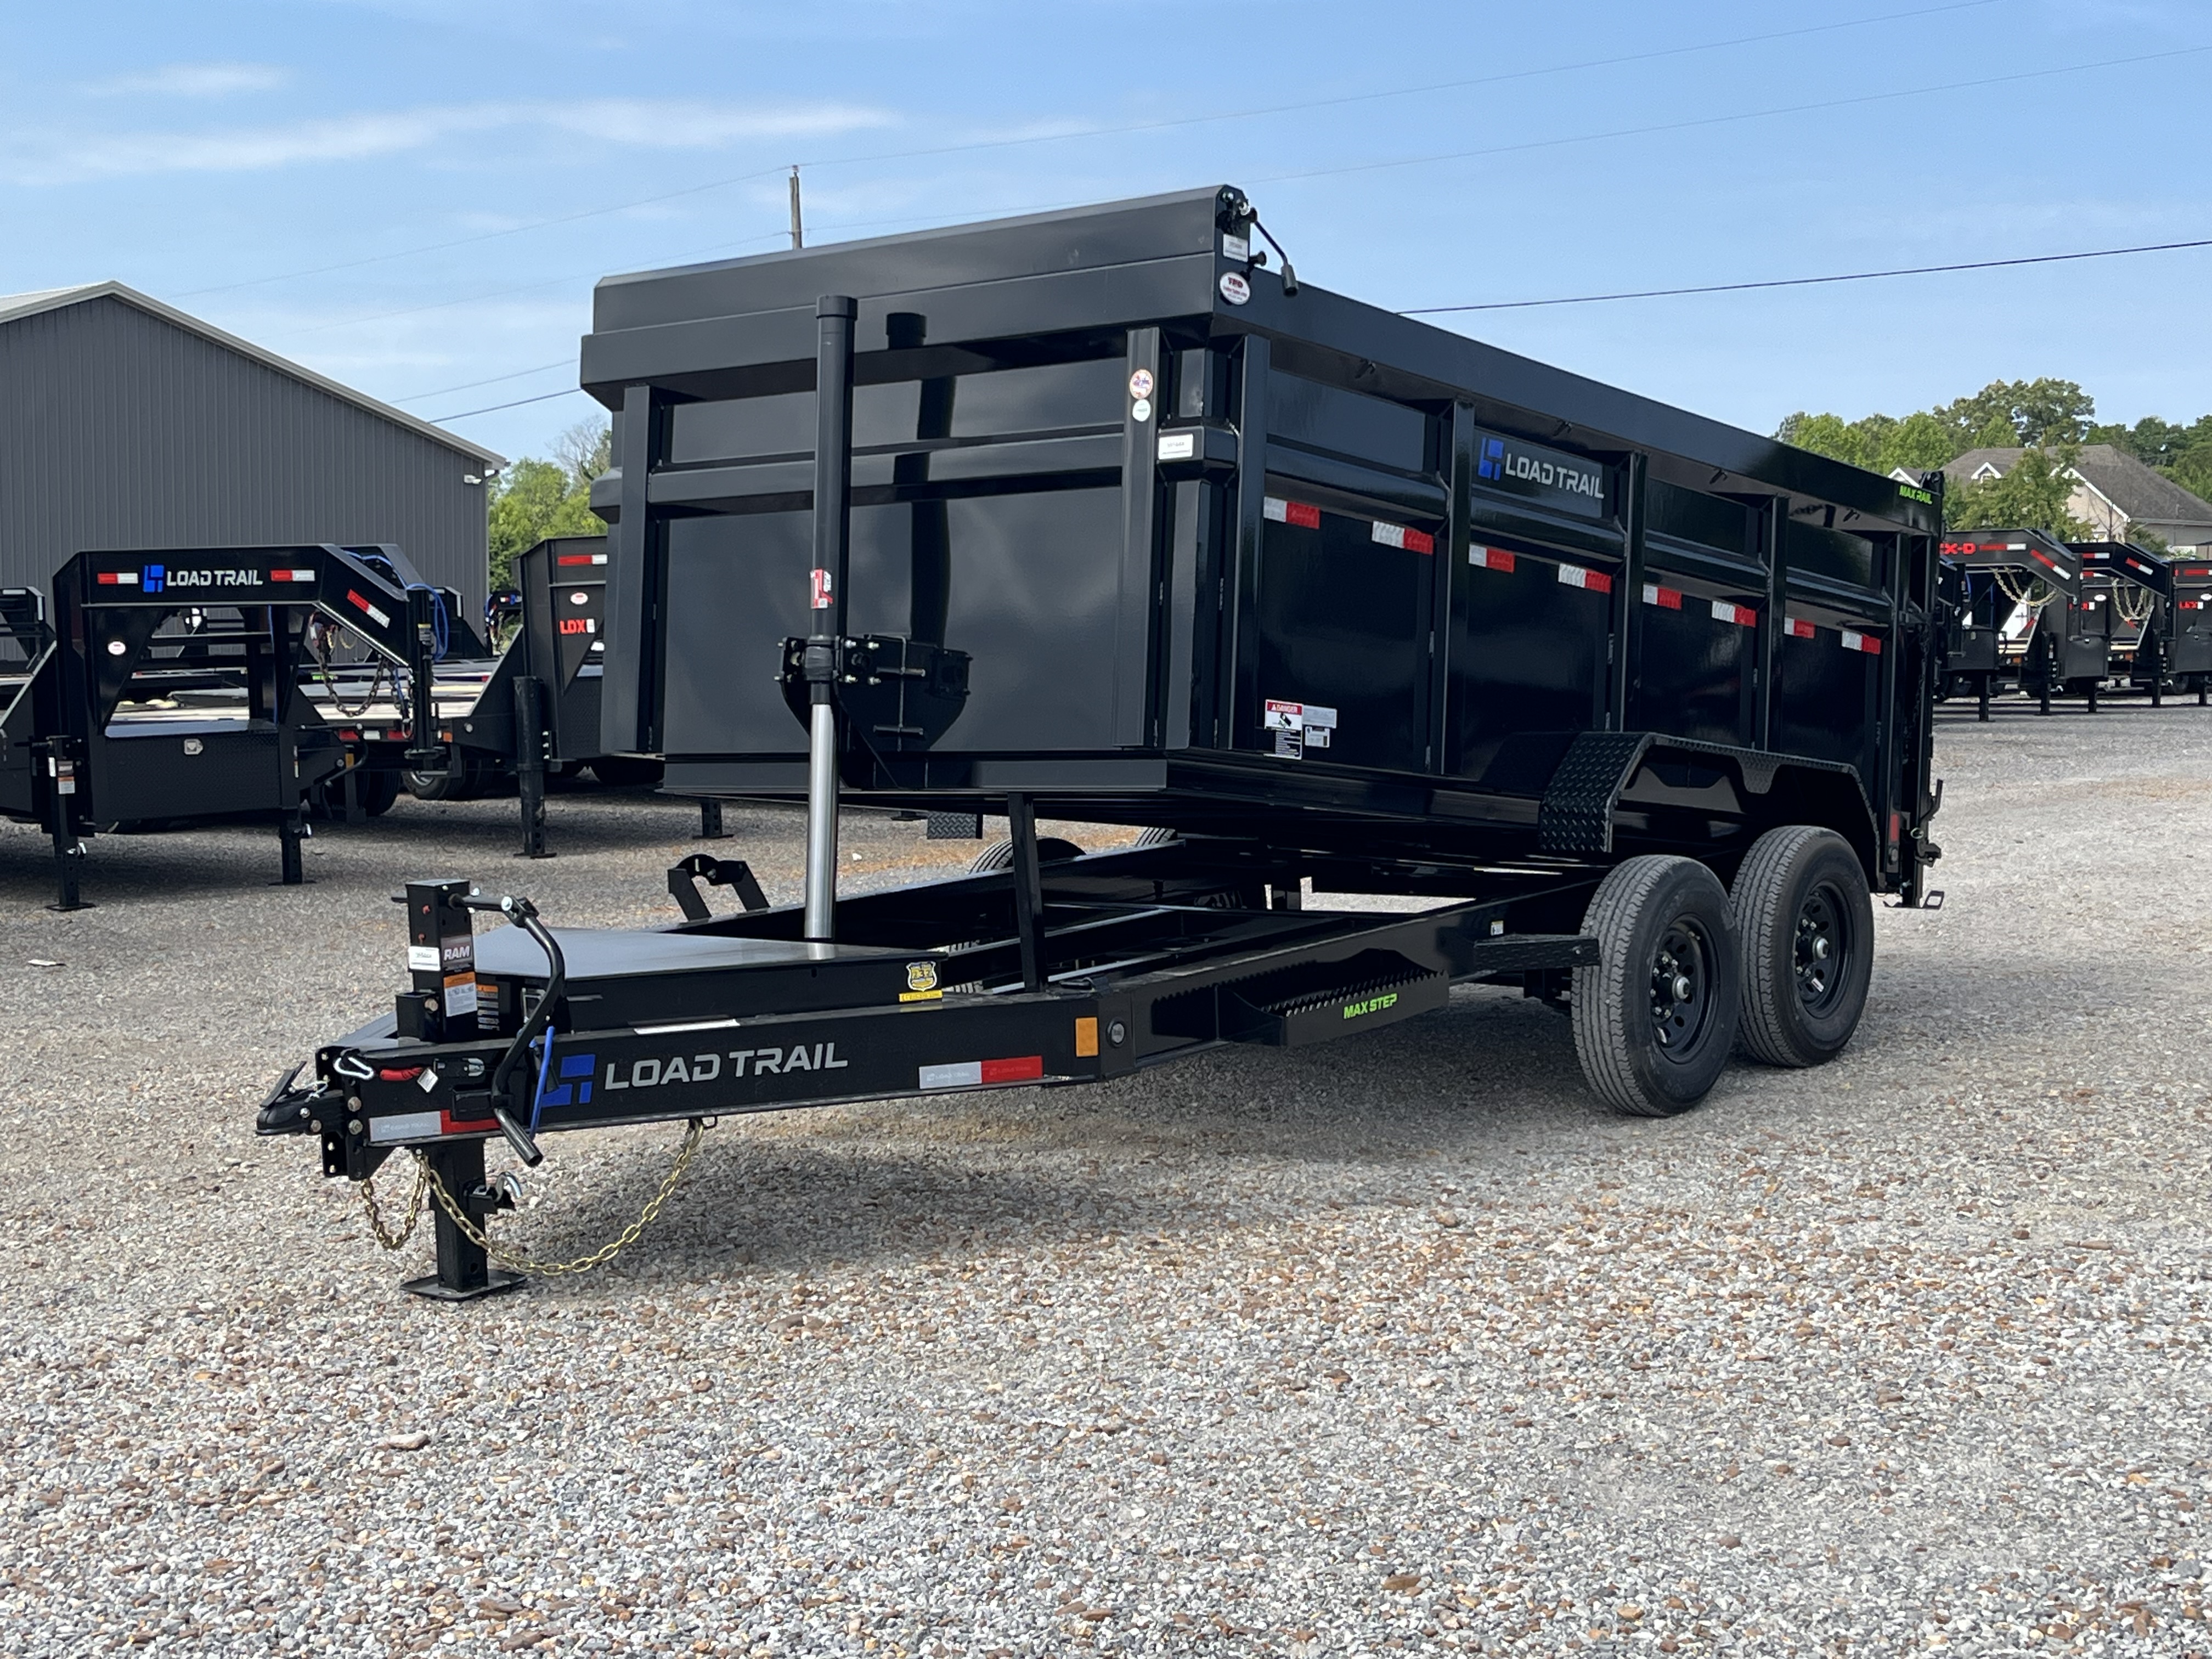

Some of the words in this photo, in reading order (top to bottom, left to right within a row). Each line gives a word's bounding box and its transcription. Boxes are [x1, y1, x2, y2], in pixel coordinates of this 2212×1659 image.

[1505, 453, 1554, 485] LOAD
[1556, 466, 1605, 499] TRAIL
[1899, 485, 1916, 500] MAX
[166, 571, 212, 586] LOAD
[213, 569, 263, 585] TRAIL
[560, 619, 586, 635] LDX
[1277, 704, 1298, 714] DANGER
[443, 945, 470, 961] RAM
[1344, 1001, 1368, 1019] MAX
[1369, 993, 1397, 1012] STEP
[605, 1053, 721, 1090] LOAD
[729, 1042, 848, 1077] TRAIL
